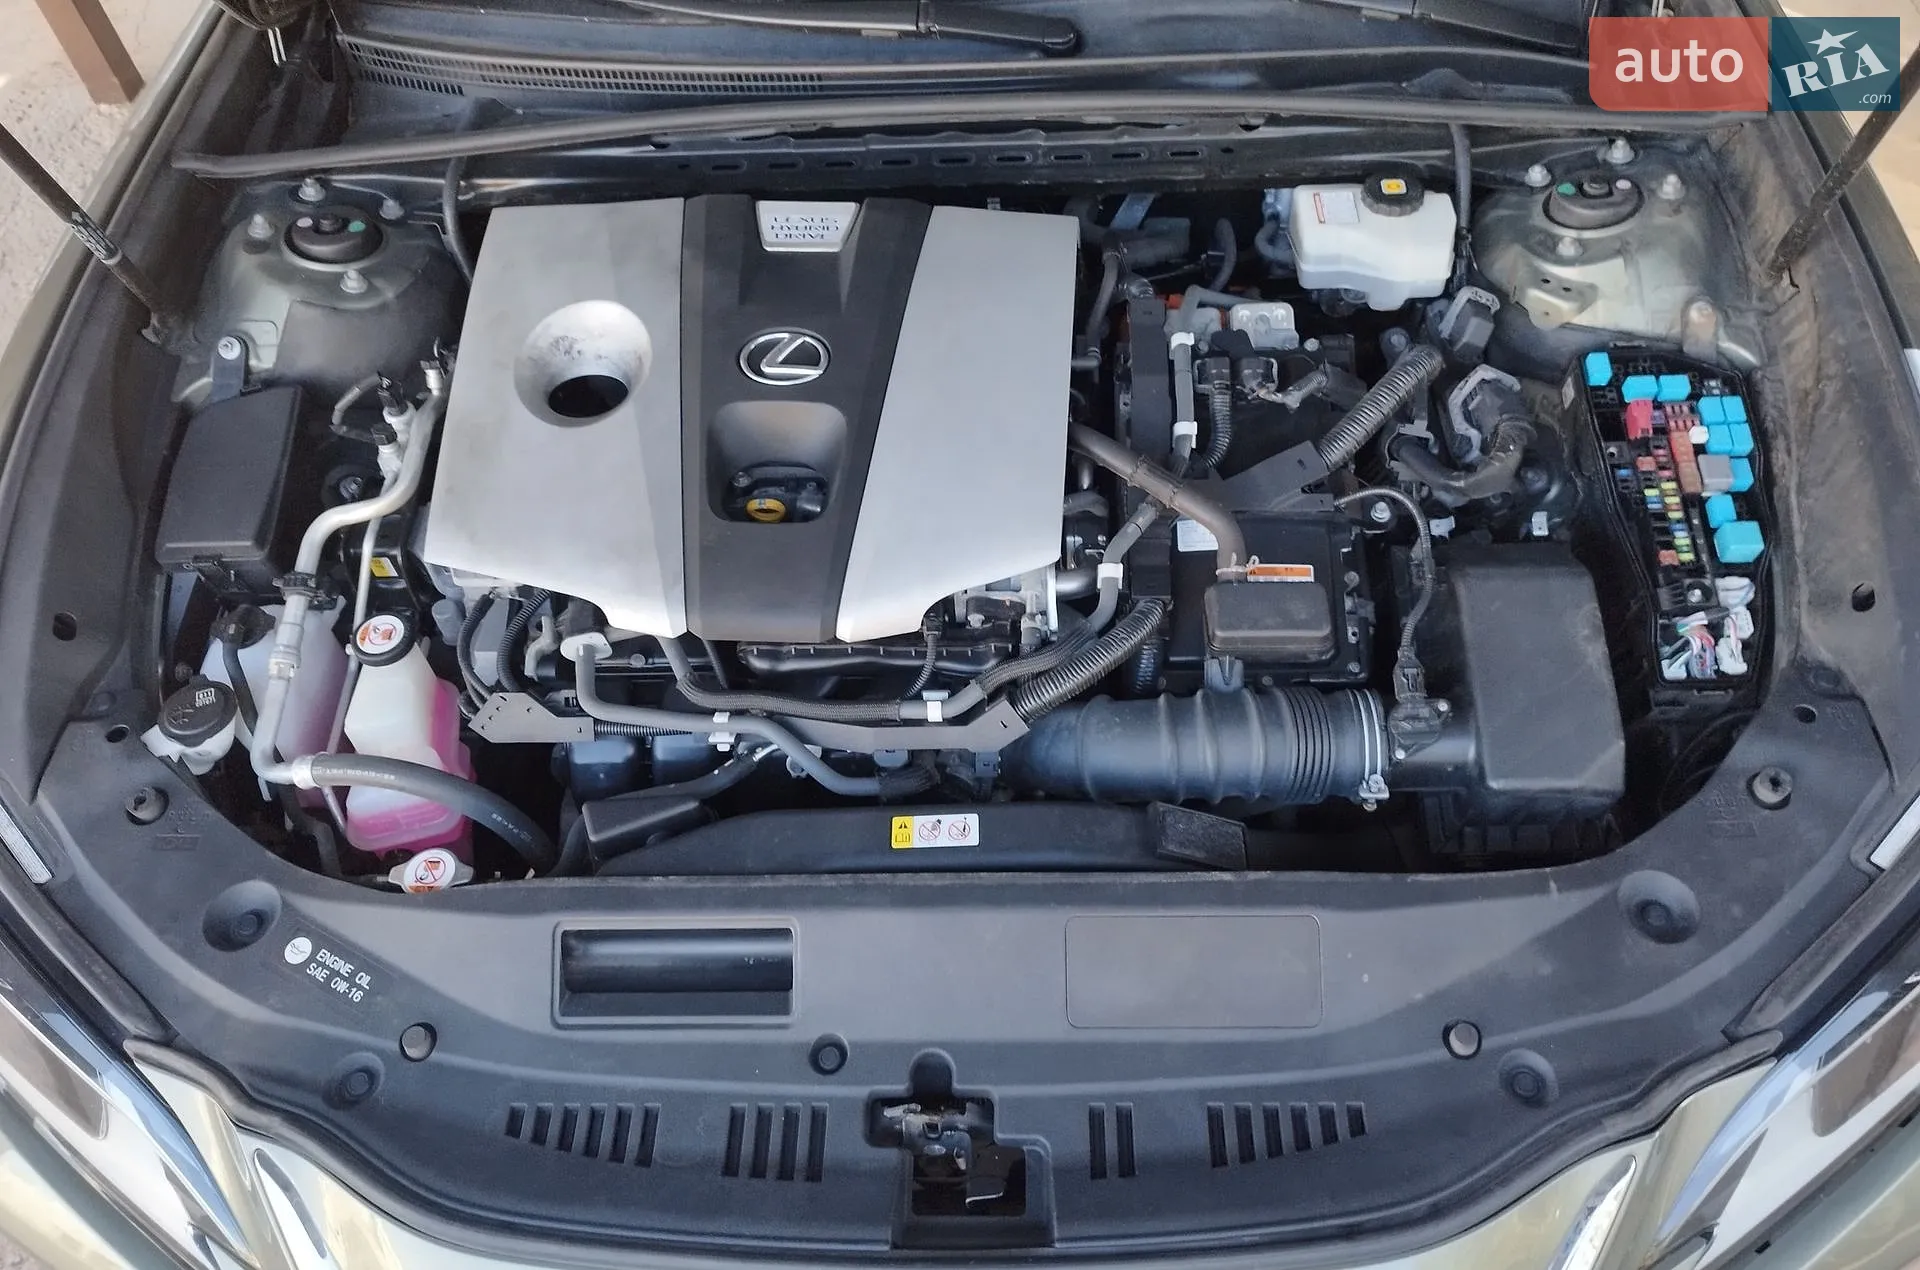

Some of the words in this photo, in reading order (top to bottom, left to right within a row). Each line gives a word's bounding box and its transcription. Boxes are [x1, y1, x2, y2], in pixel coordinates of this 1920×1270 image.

[306, 963, 330, 983] SAE
[316, 948, 355, 977] ENGINE
[355, 972, 371, 990] OIL
